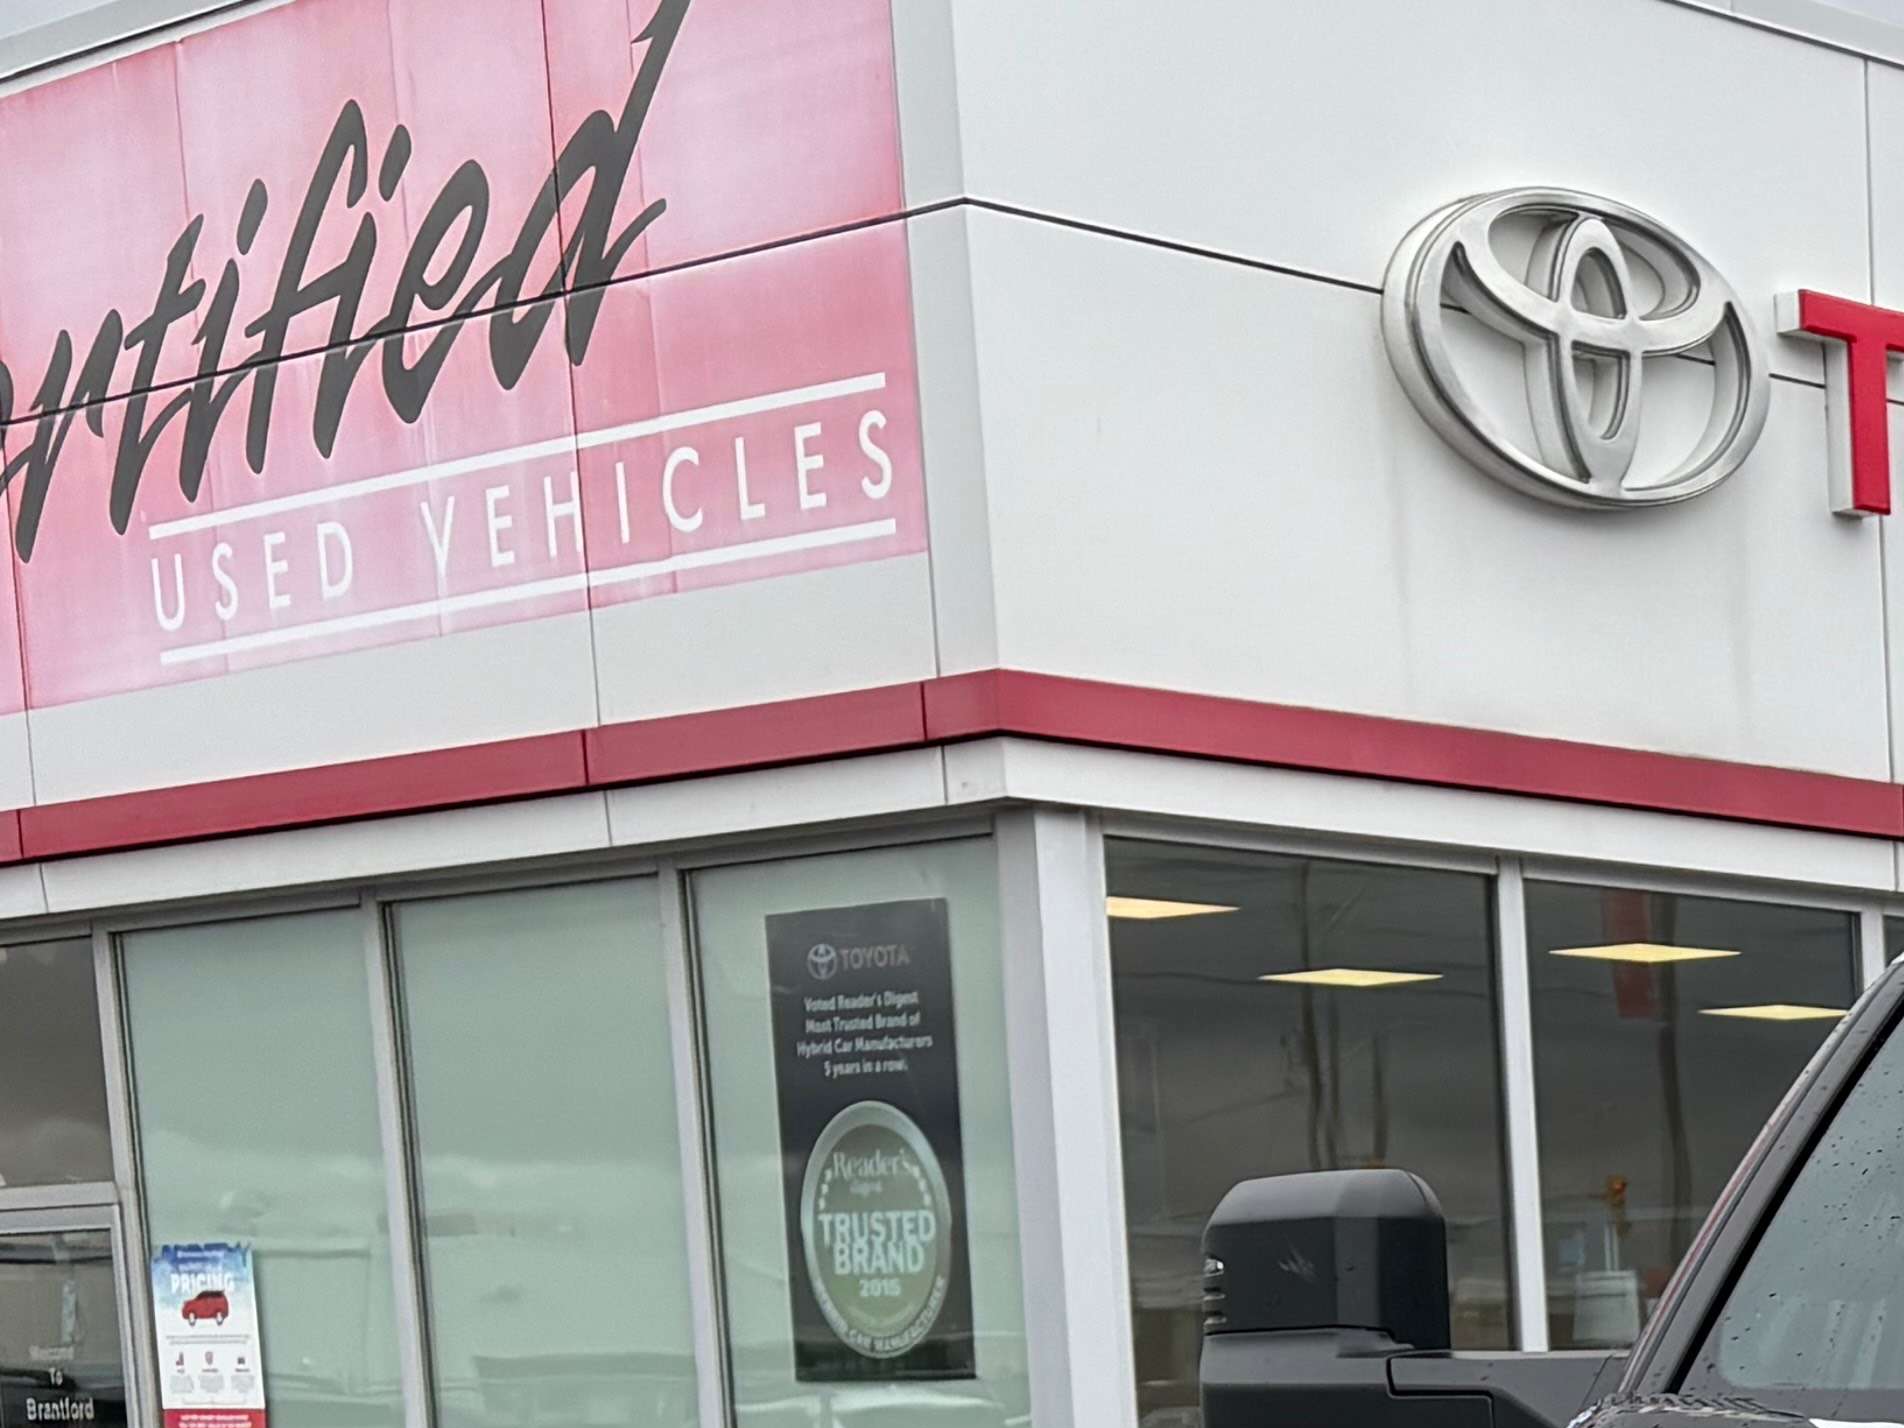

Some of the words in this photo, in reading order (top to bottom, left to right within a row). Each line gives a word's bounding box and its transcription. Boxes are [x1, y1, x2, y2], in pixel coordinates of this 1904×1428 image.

[150, 521, 354, 631] USED
[421, 410, 894, 586] VEHICLES
[841, 944, 911, 970] TOYOTA
[804, 996, 836, 1012] Voted
[837, 993, 882, 1011] Reader's
[884, 990, 919, 1009] Digest
[805, 1018, 832, 1034] Most
[833, 1016, 874, 1032] Trusted
[875, 1013, 907, 1029] Brand
[909, 1012, 921, 1027] of
[797, 1040, 833, 1059] Hybrid
[834, 1039, 853, 1054] Car
[855, 1035, 933, 1052] Manufacturers
[832, 1062, 861, 1079] years
[862, 1059, 873, 1073] in
[875, 1061, 882, 1072] a
[817, 1209, 936, 1247] TRUSTED
[833, 1240, 924, 1275] BRAND
[170, 1272, 236, 1294] PRICING
[26, 1397, 95, 1420] Brantford
